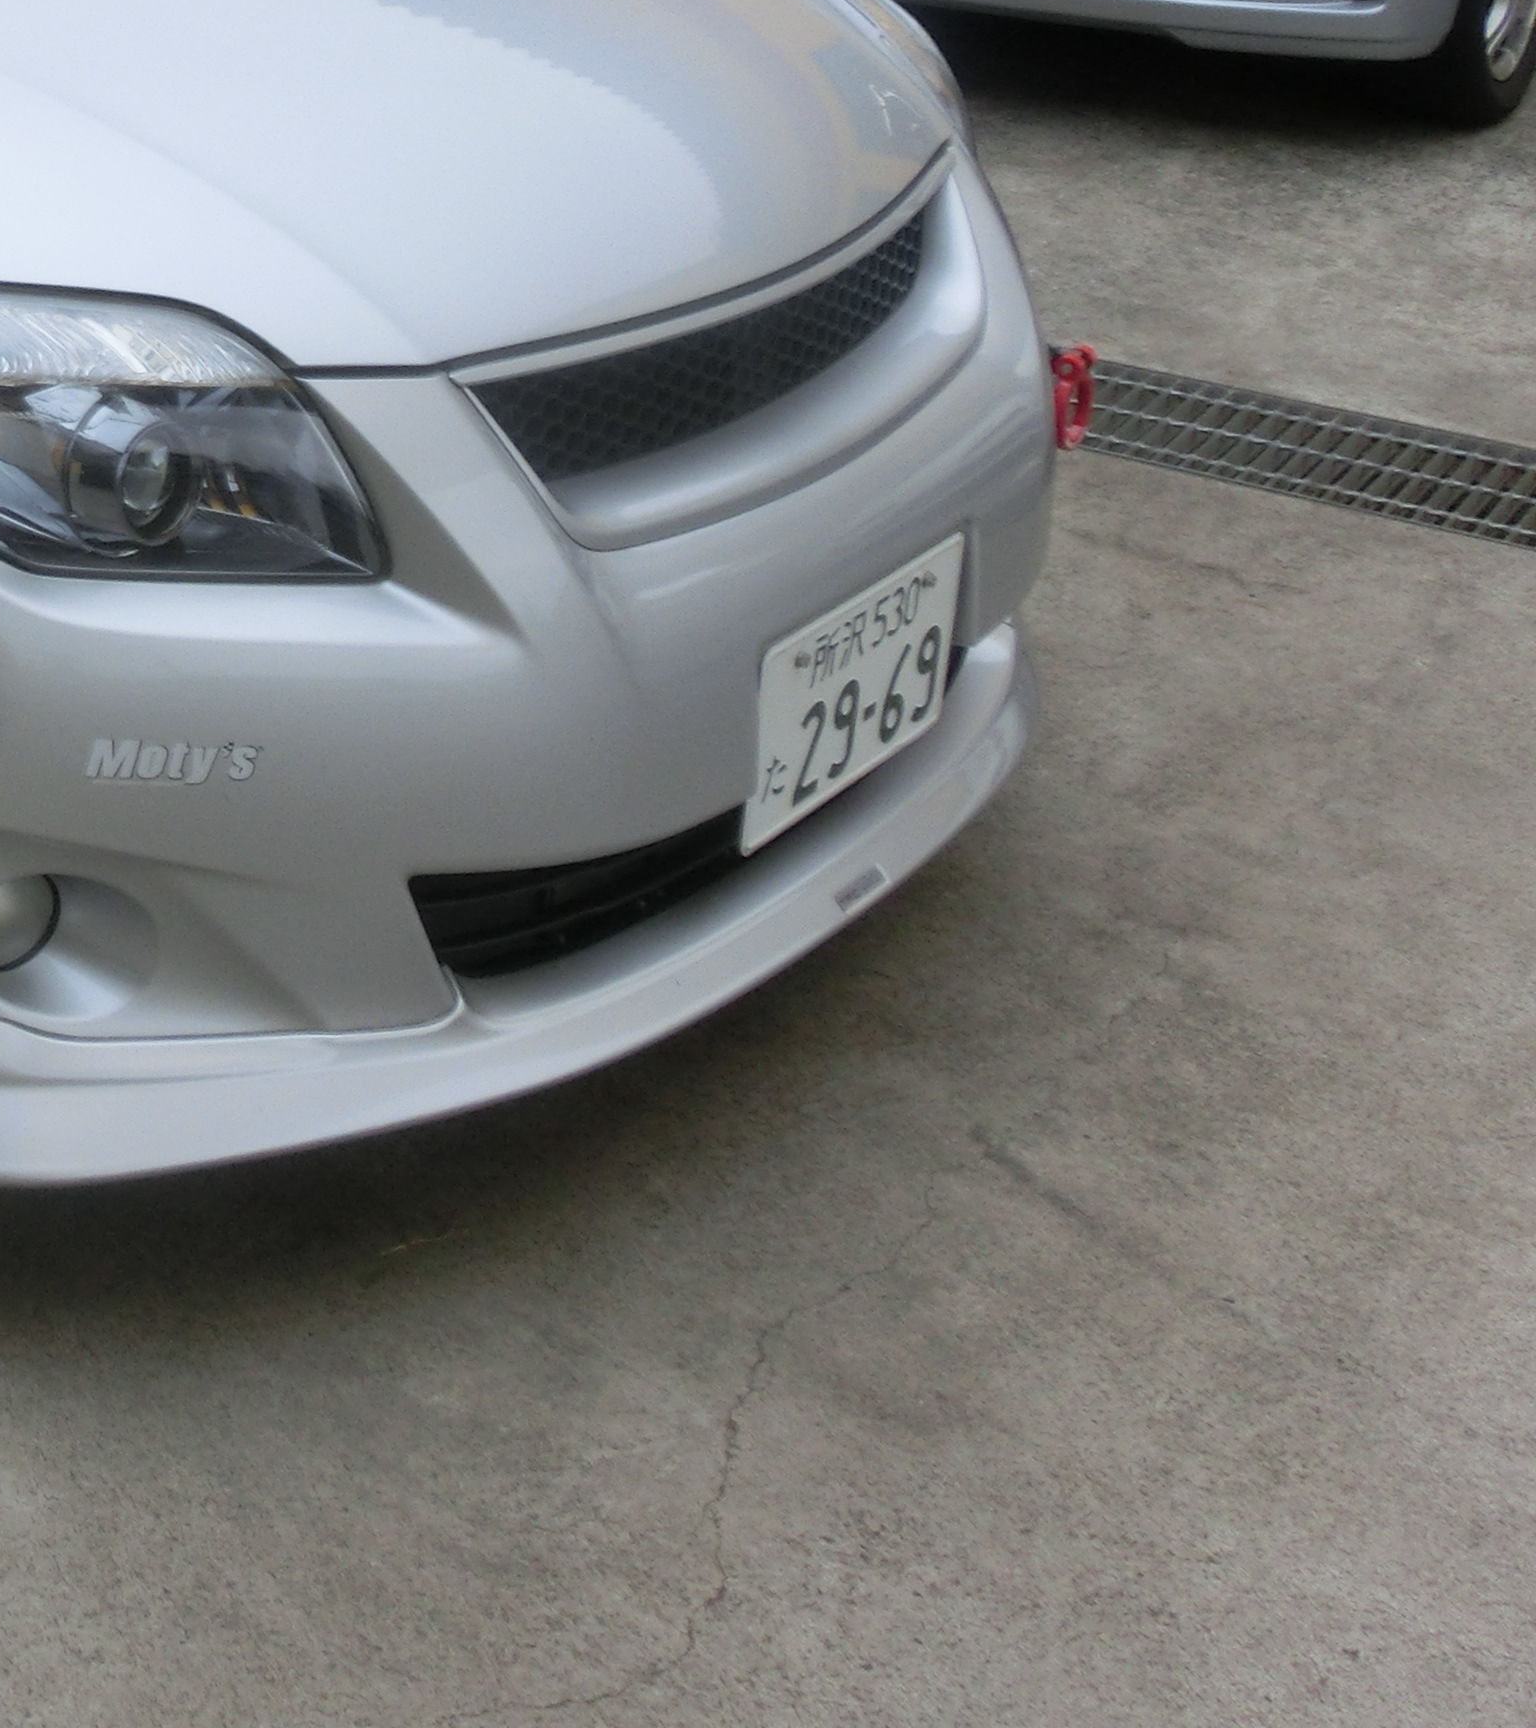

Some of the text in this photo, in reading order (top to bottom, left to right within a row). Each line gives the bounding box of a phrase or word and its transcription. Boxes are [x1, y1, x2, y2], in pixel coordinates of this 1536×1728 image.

[85, 737, 259, 786] Moty's
[760, 624, 942, 807] た 29-69
